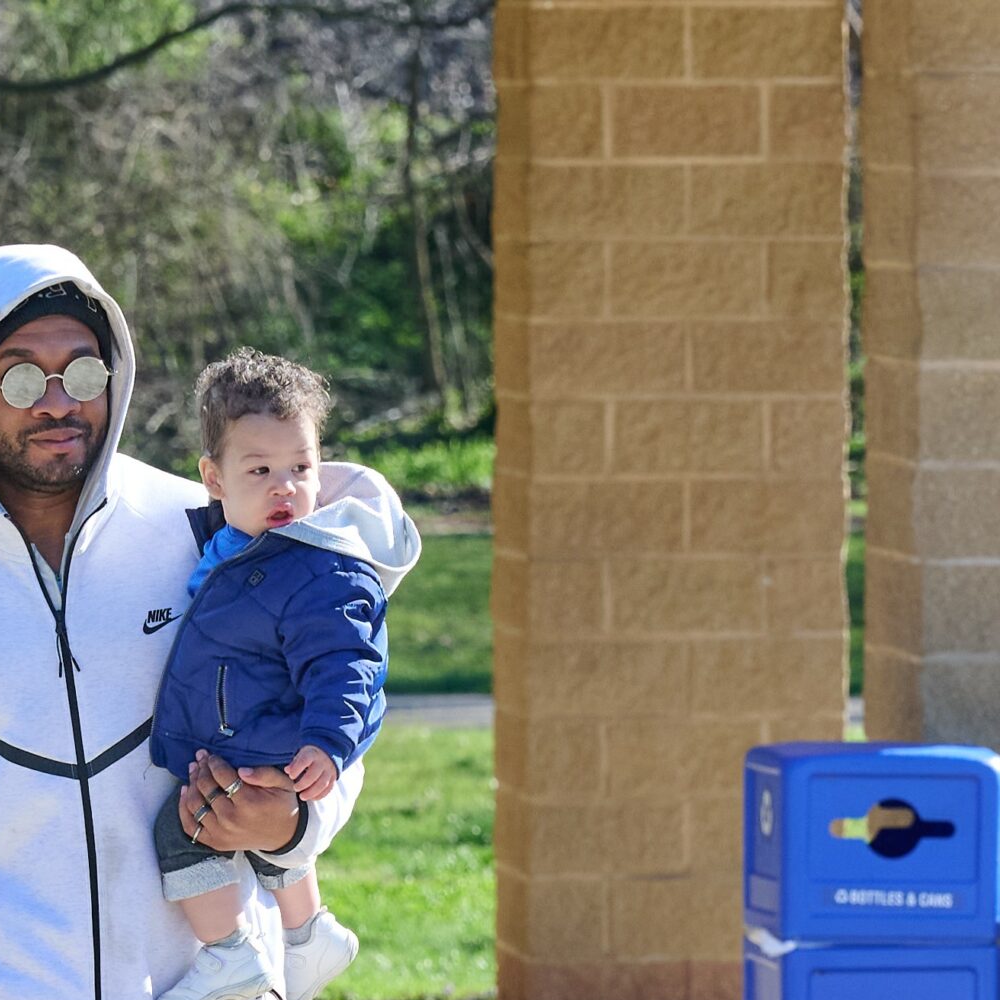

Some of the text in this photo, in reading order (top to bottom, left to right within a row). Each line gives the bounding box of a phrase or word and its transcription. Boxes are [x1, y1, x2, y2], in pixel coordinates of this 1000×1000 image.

[147, 607, 172, 623] NIKE
[849, 889, 953, 908] BOTTLES & CANS
